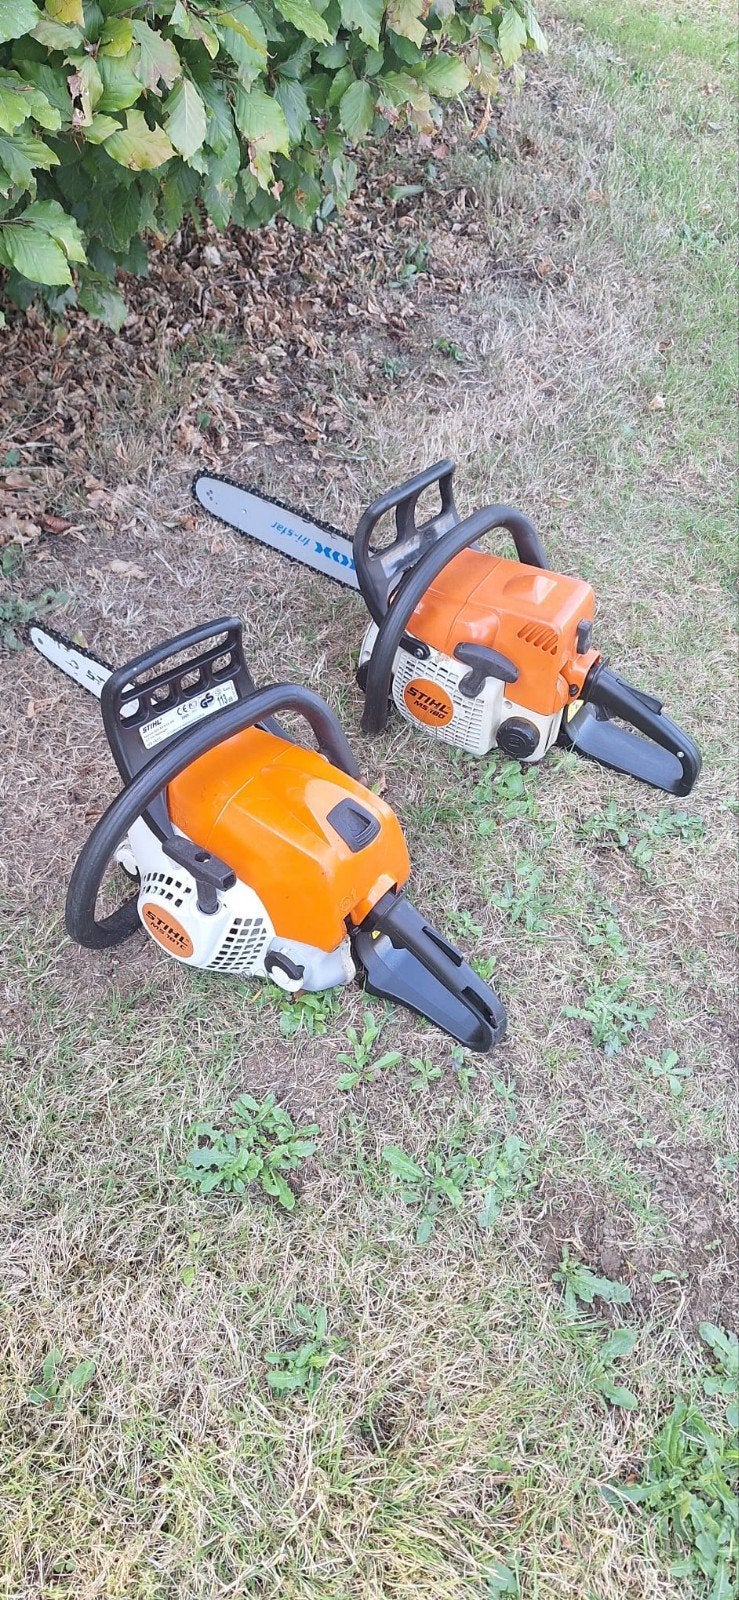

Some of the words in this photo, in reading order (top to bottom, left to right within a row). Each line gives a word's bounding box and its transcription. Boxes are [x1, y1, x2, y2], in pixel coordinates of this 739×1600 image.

[407, 686, 449, 715] STIHL
[413, 700, 429, 711] MS
[429, 709, 446, 719] 180
[142, 719, 162, 734] STIHL
[146, 910, 188, 947] STIHL
[150, 922, 165, 935] MS
